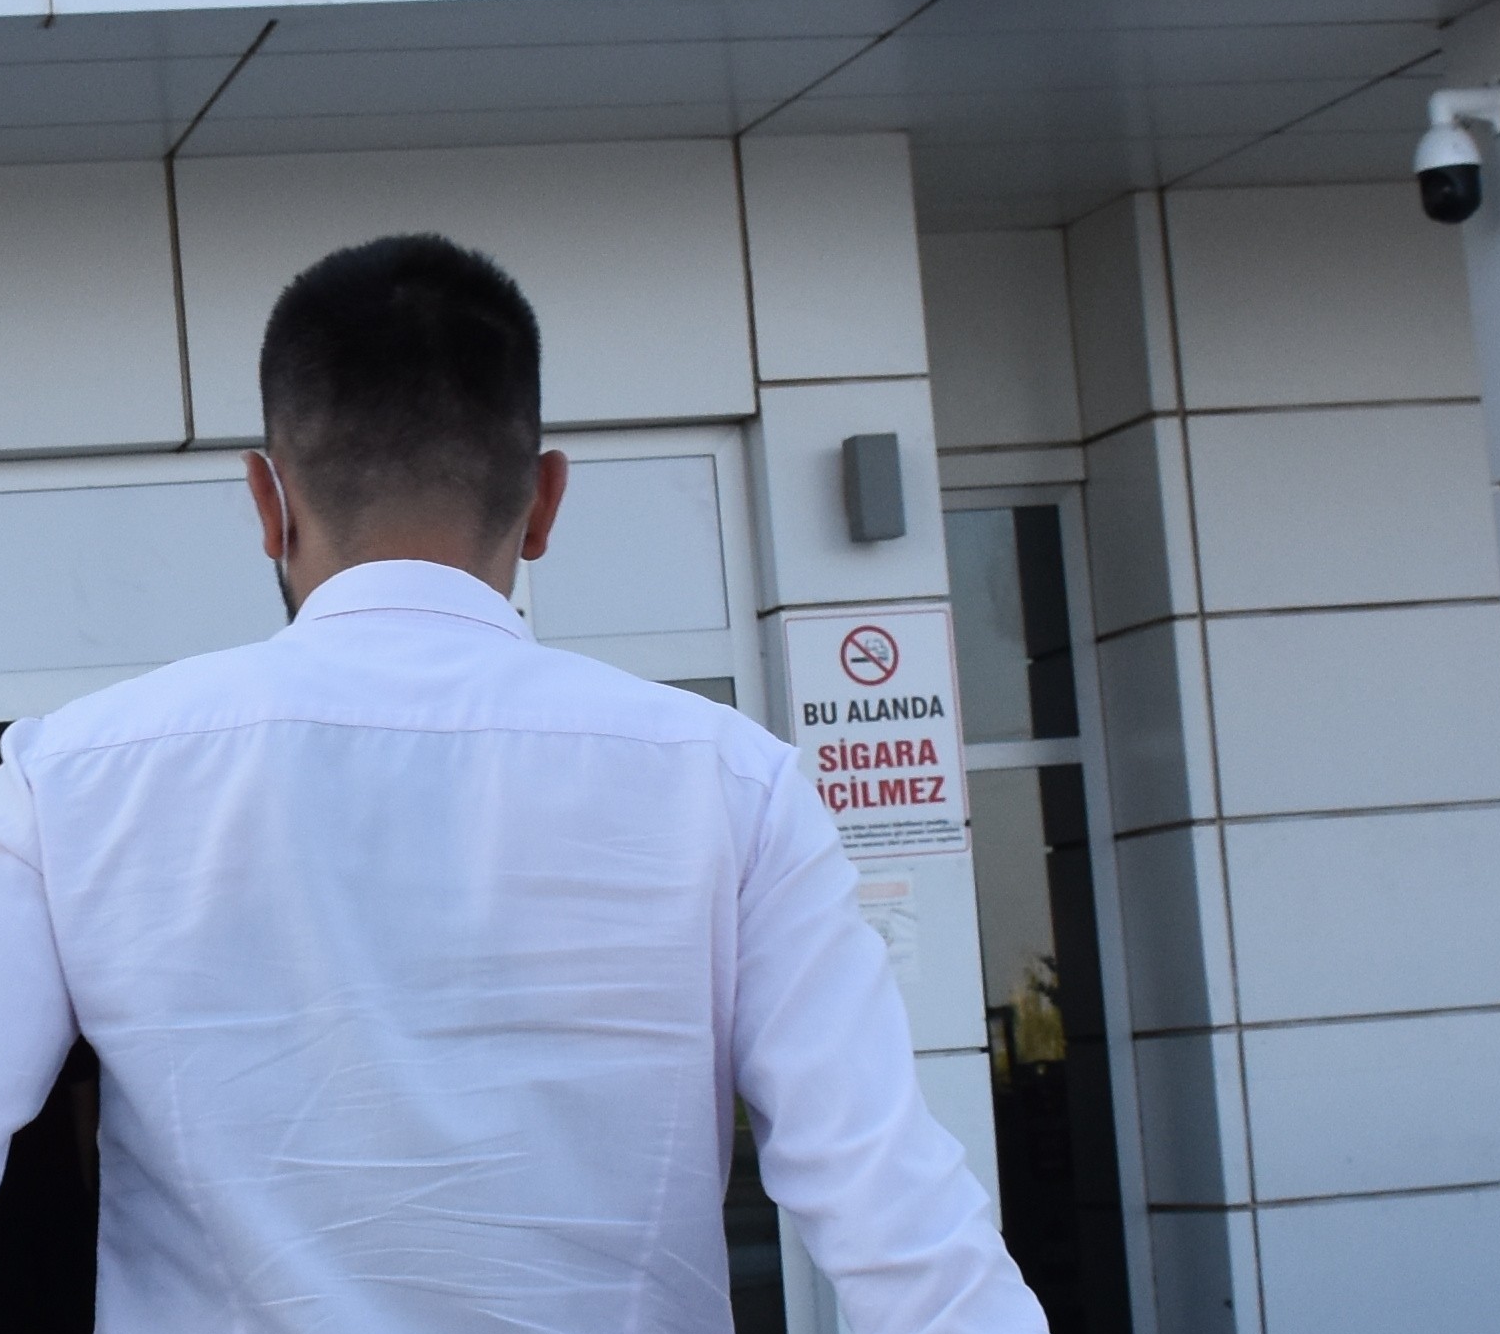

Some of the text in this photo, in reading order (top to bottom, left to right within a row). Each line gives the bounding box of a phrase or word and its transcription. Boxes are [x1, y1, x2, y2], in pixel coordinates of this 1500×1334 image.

[803, 694, 944, 726] BU ALANDA
[818, 738, 939, 773] SİGARA
